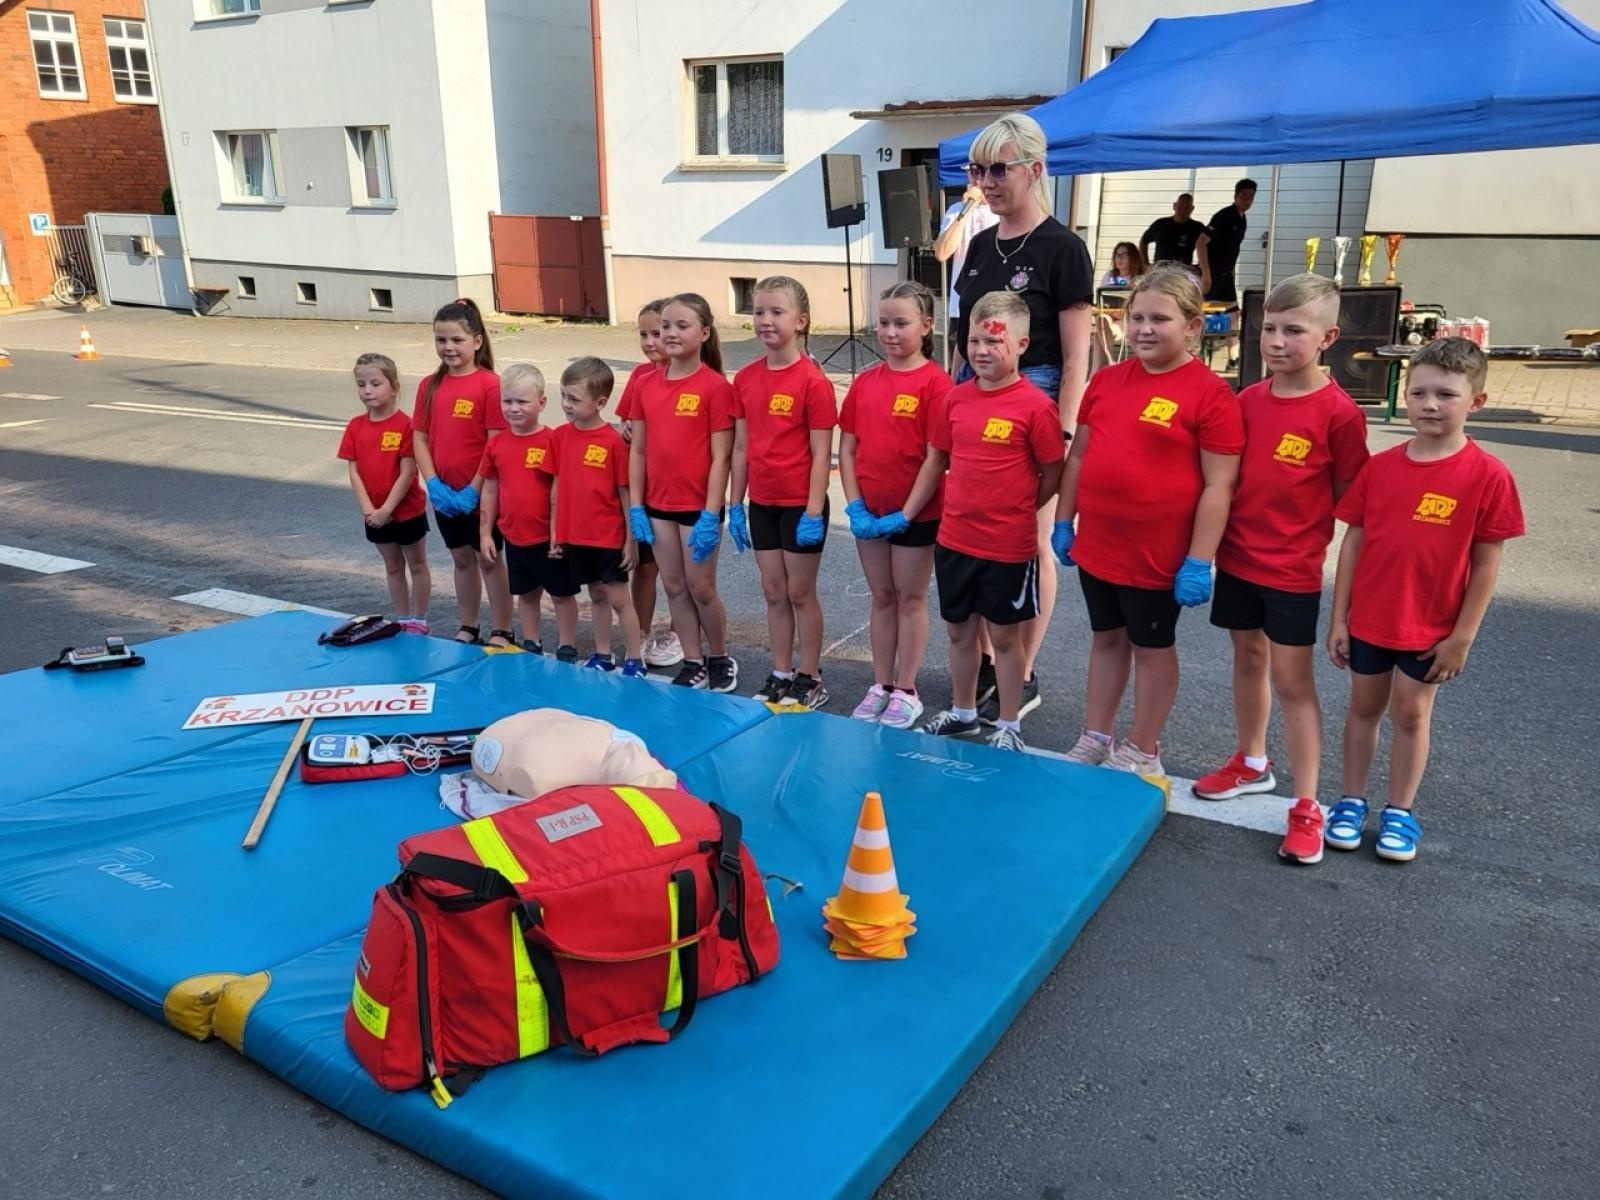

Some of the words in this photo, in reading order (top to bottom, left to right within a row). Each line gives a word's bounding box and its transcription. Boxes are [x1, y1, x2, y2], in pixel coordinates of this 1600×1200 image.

[876, 147, 892, 162] 19
[285, 688, 355, 703] DDP
[189, 698, 429, 726] KRZANOWICE
